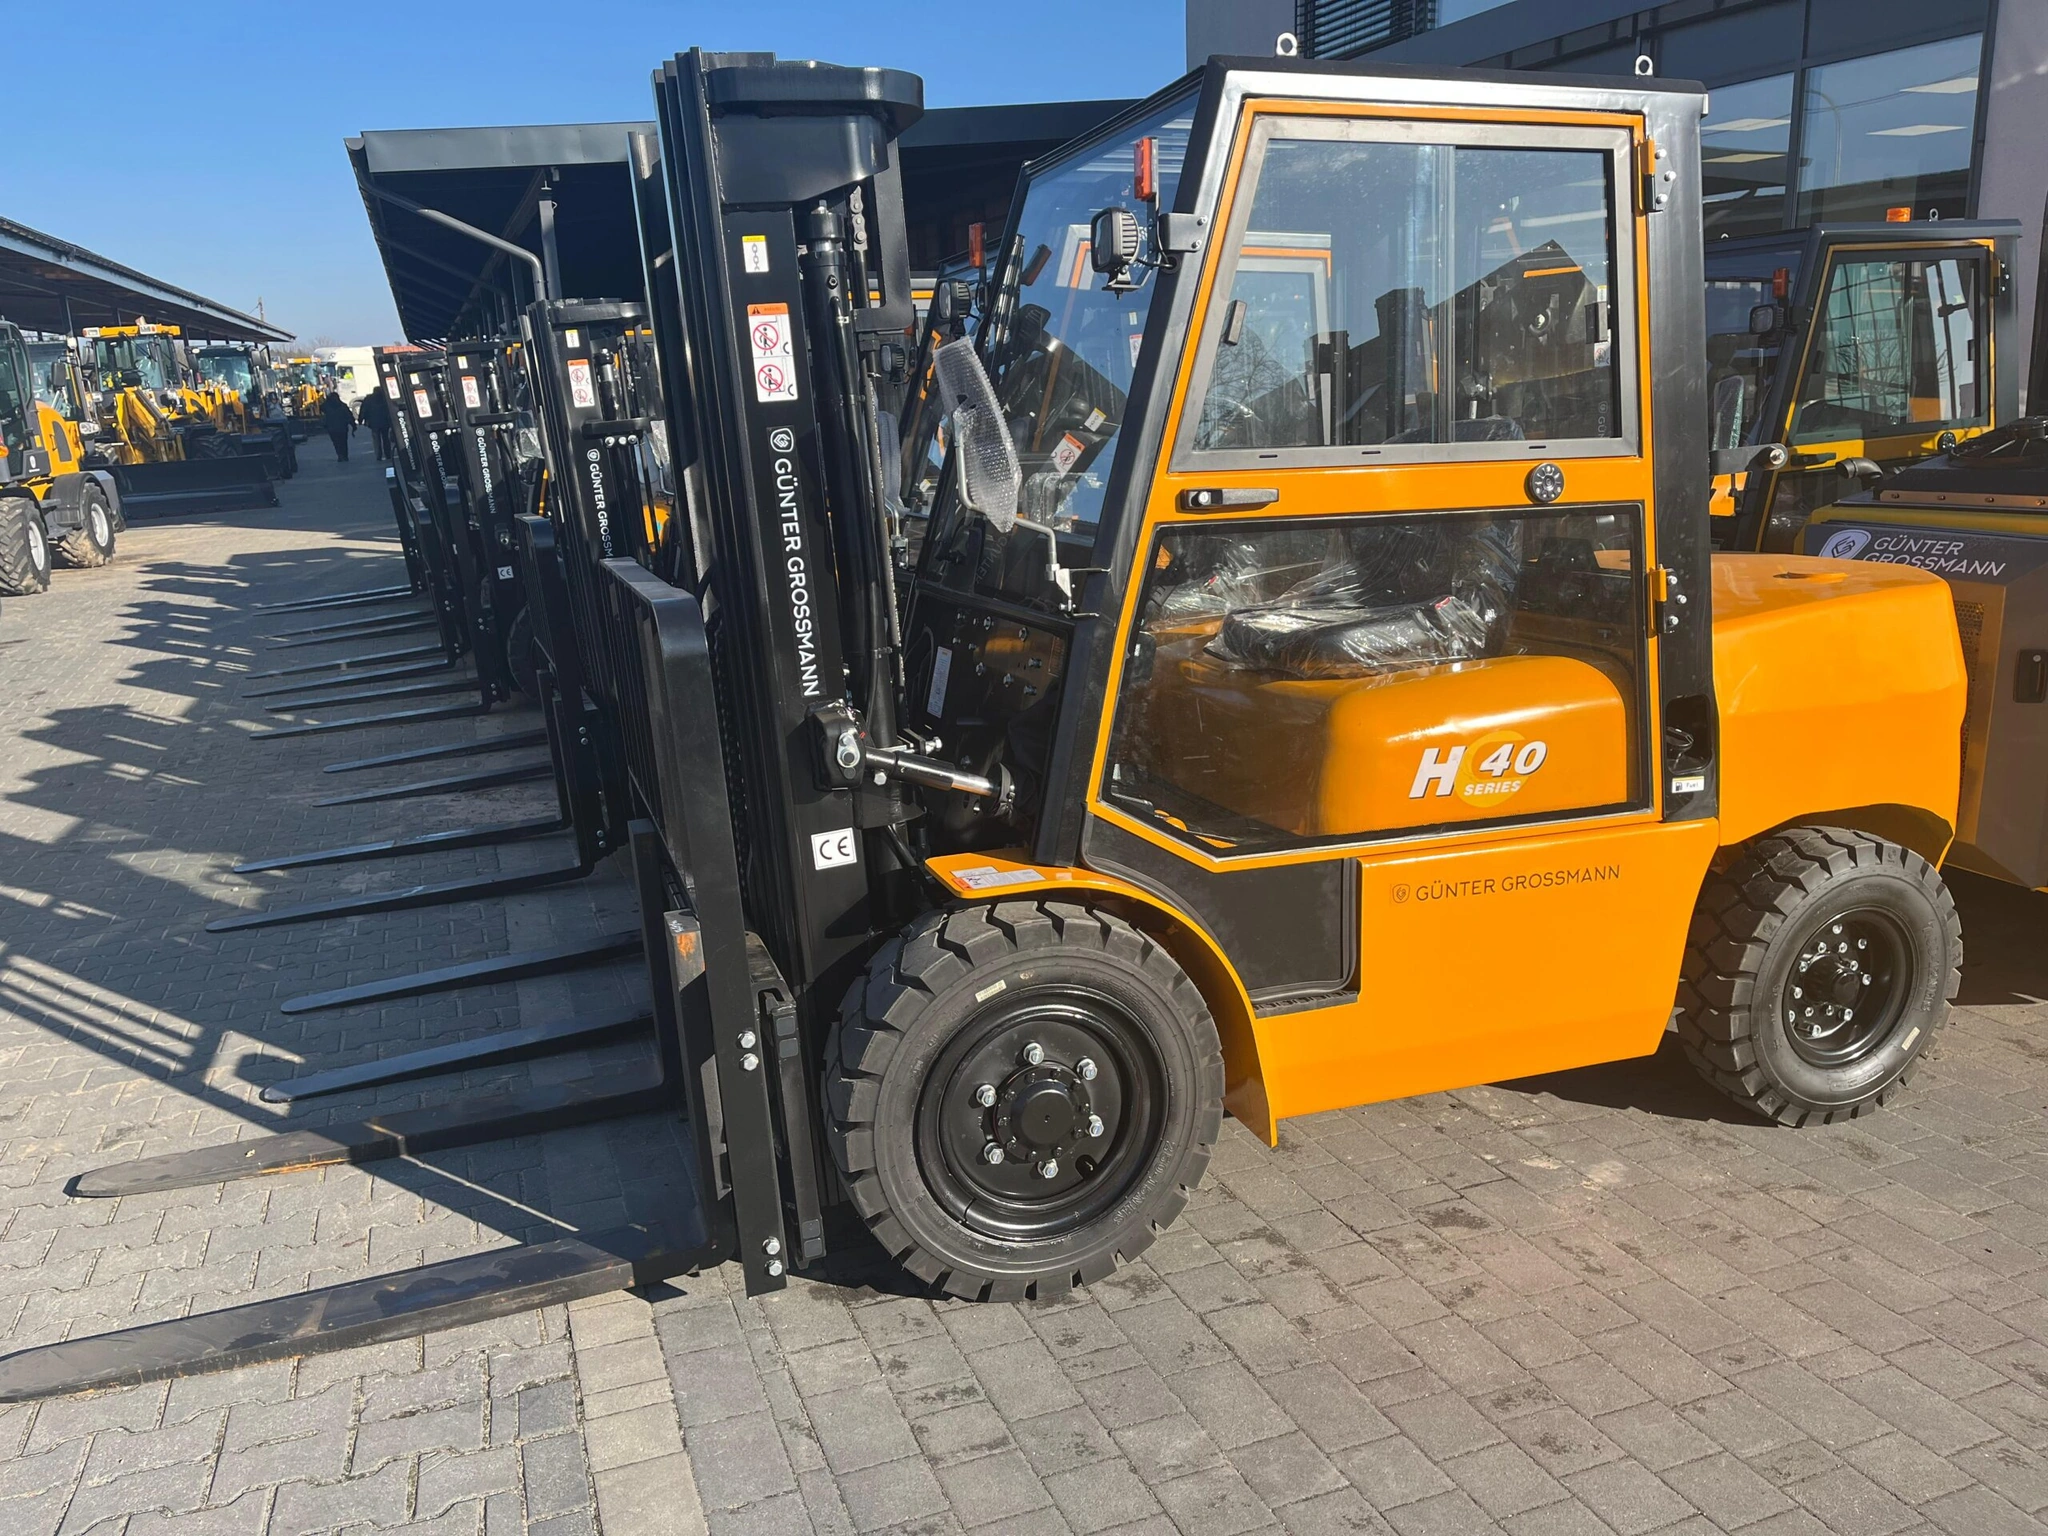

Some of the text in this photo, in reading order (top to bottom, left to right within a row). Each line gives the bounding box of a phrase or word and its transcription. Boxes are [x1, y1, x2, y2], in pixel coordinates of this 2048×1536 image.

[477, 437, 496, 514] GÜNTER GROSSMANN
[589, 463, 606, 509] GÜNTER
[1874, 535, 1964, 556] GÜNTER
[499, 568, 512, 577] CE
[774, 458, 820, 696] GÜNTER GROSSMANN
[1863, 552, 2006, 577] GROSSMANN
[1409, 740, 1547, 799] H 40
[1463, 780, 1521, 796] SERIES
[819, 836, 850, 860] CE
[1415, 864, 1621, 901] GÜNTER GROSSMANN
